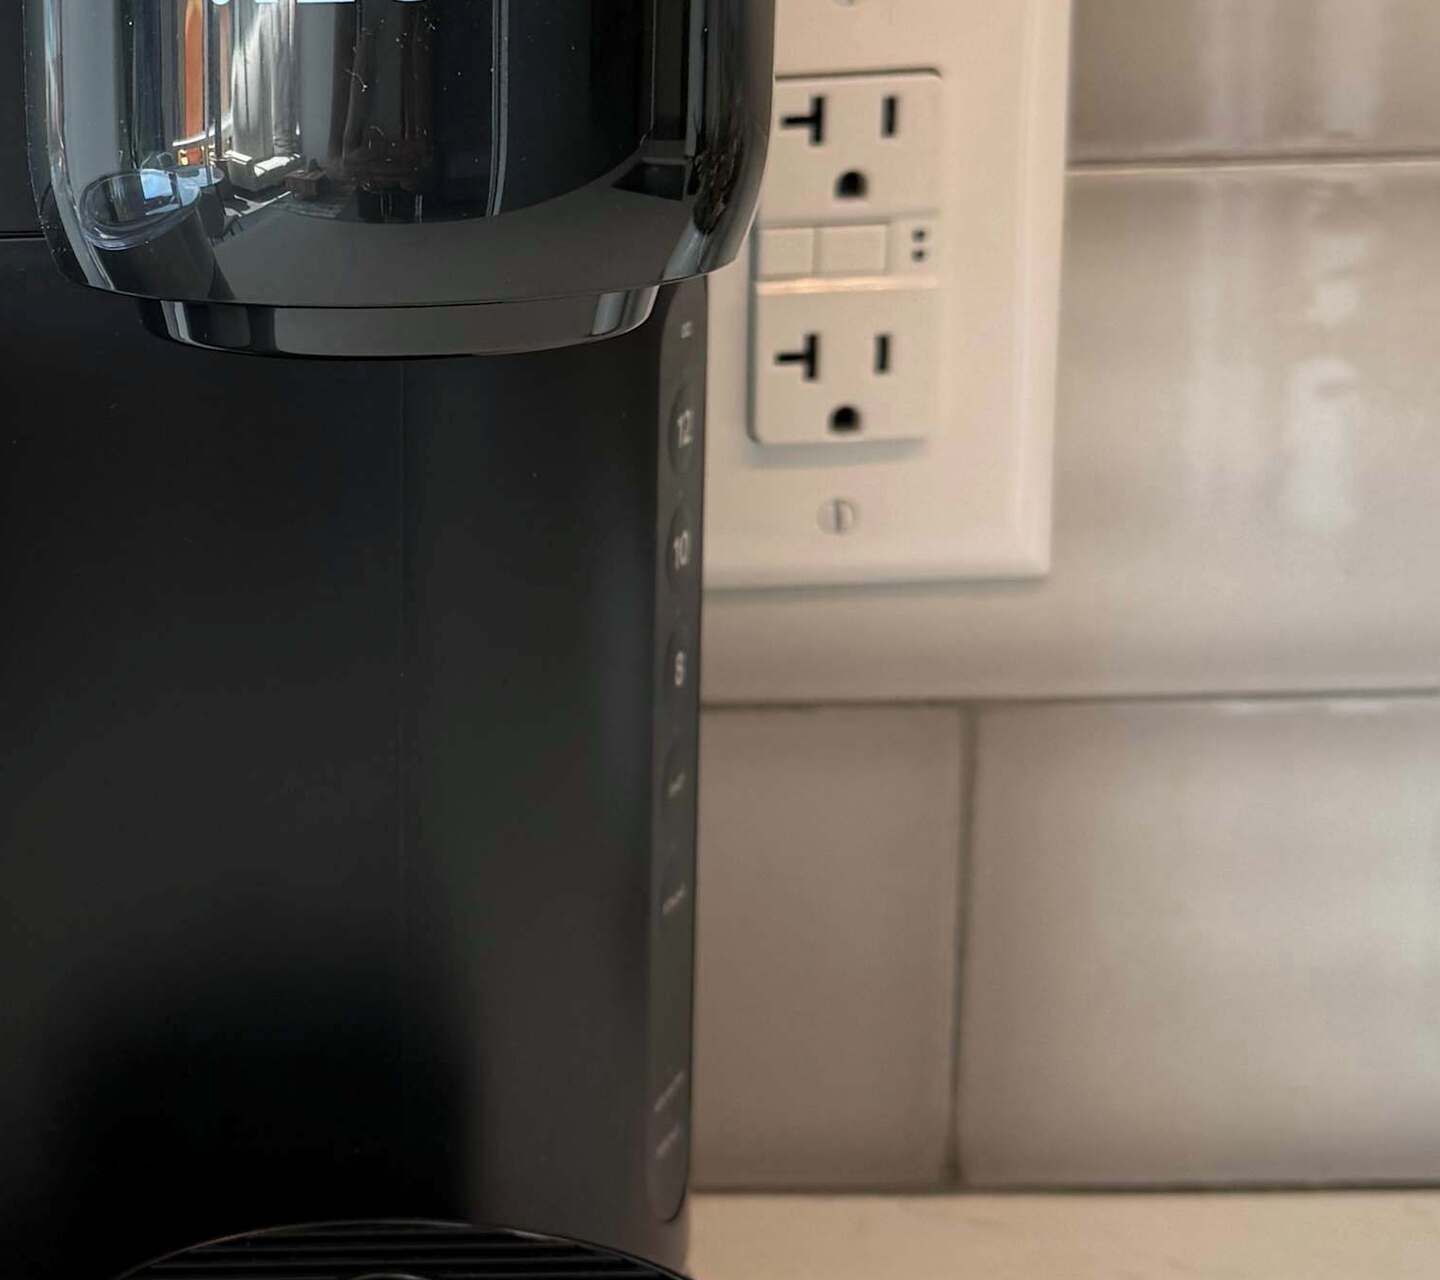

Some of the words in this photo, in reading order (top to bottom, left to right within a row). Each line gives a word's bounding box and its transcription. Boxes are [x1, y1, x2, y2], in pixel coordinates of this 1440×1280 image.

[676, 409, 693, 448] 12
[673, 530, 689, 571] 10
[674, 651, 686, 687] 8
